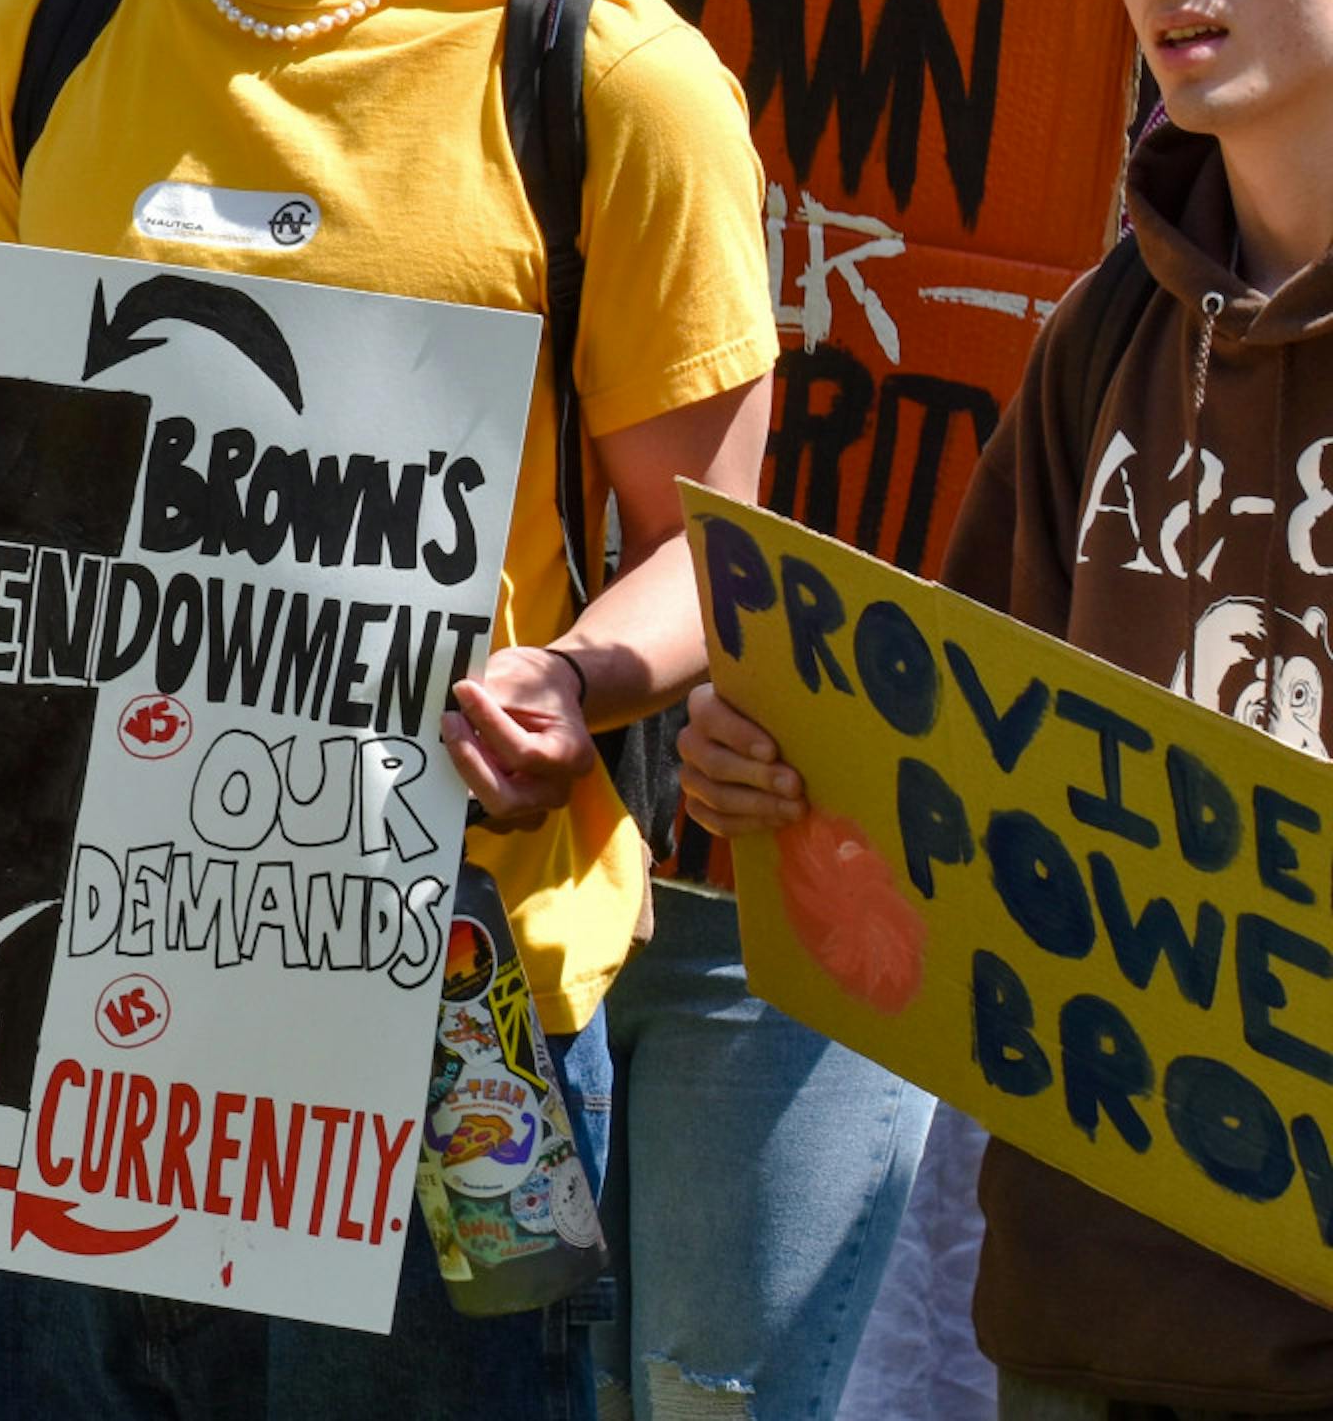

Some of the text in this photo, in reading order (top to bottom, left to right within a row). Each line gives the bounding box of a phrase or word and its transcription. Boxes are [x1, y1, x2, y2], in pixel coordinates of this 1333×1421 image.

[145, 217, 204, 232] NAUTICA
[140, 416, 485, 586] BROWN'S
[691, 511, 1322, 906] PROVIDE
[190, 729, 438, 863] OUR
[68, 841, 450, 989] DEMANDS
[34, 1058, 415, 1246] CURRENTLY.
